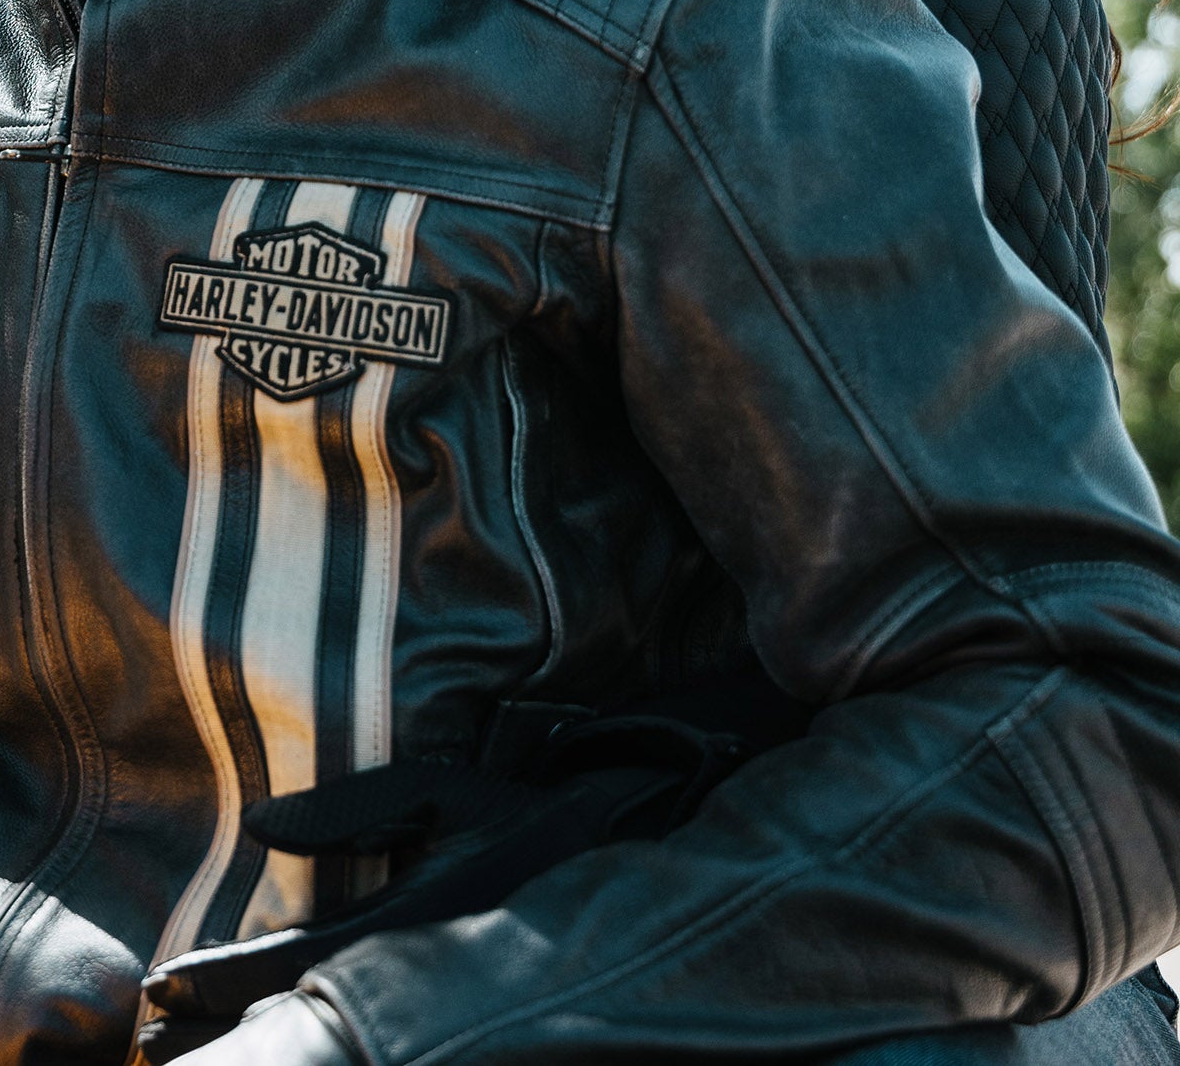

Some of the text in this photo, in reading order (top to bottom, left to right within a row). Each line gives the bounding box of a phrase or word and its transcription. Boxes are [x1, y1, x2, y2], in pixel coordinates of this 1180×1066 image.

[247, 234, 360, 283] MOTOR
[170, 272, 436, 351] HARLEY-DAVIDSON
[231, 339, 342, 387] CYCLES
